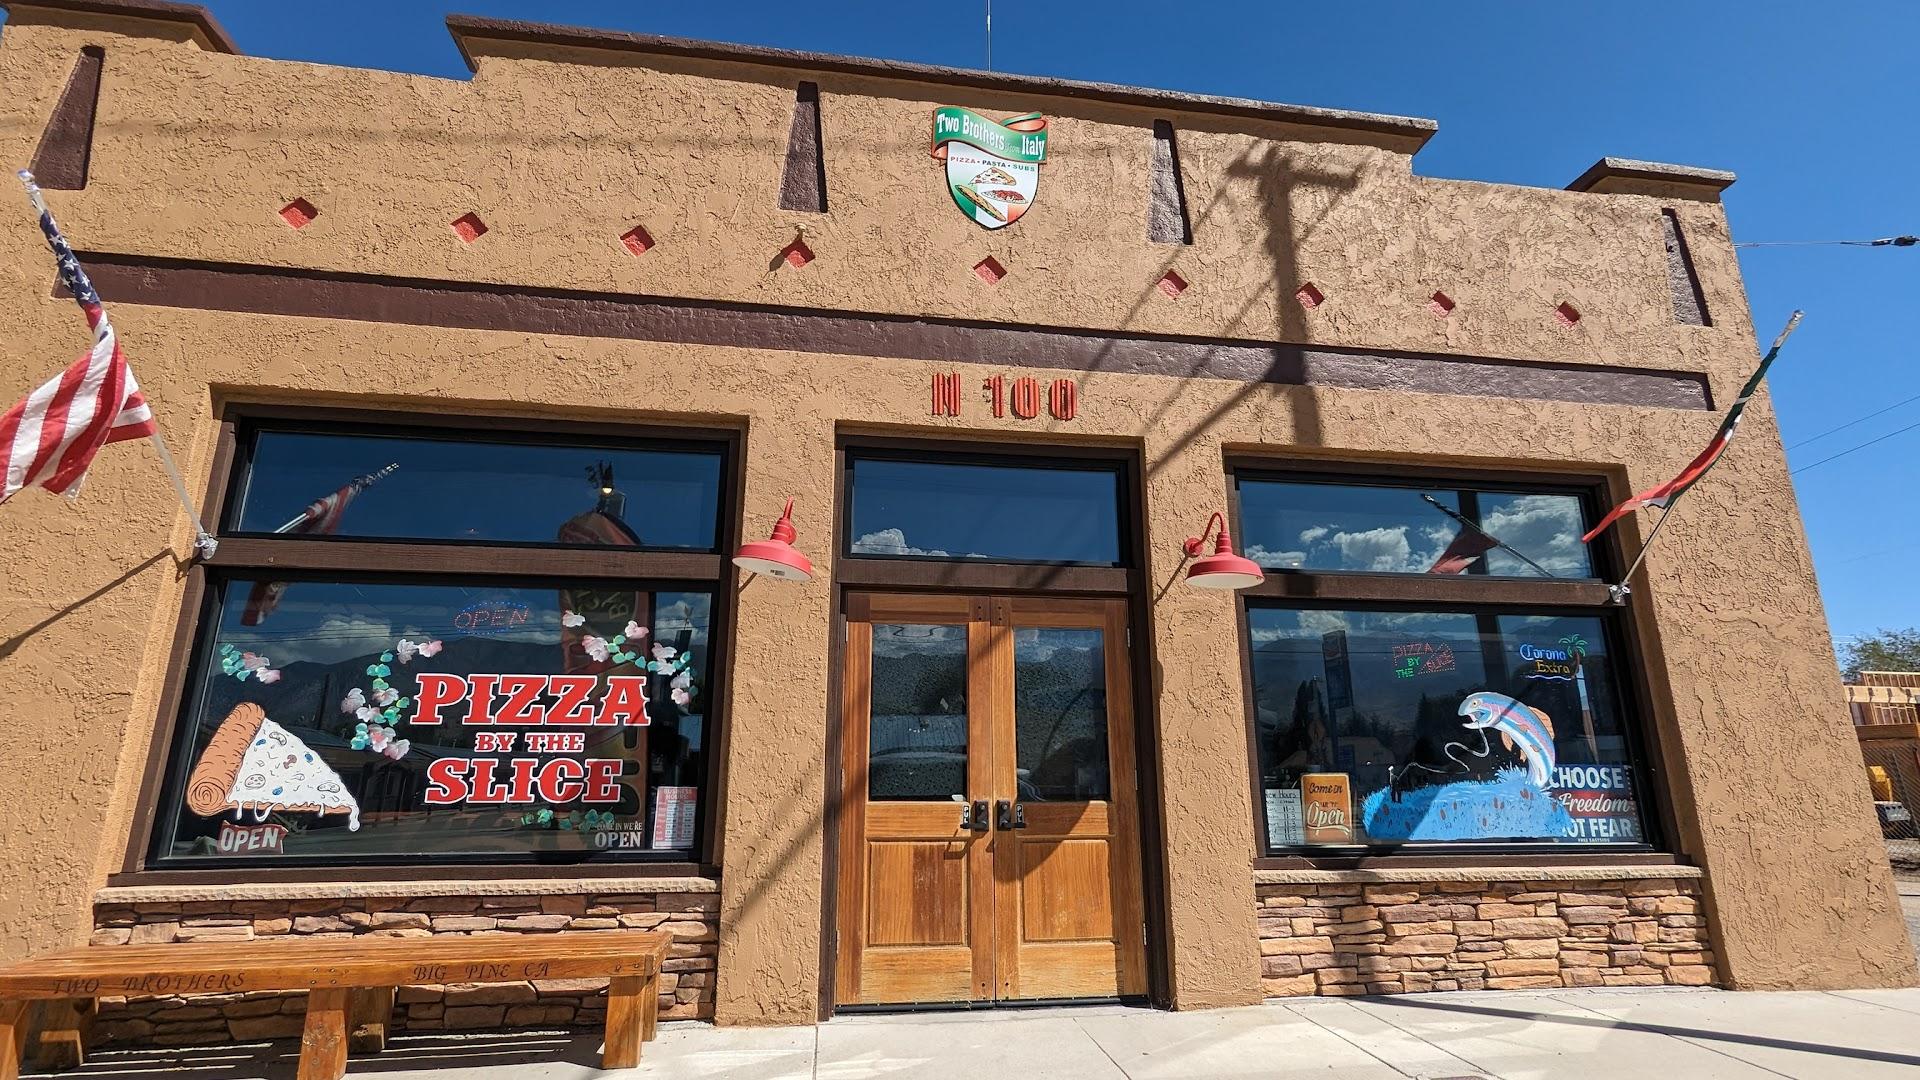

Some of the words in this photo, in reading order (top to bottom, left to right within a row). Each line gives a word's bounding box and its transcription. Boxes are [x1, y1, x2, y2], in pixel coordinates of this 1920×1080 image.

[937, 113, 959, 133] Two
[963, 115, 1005, 151] Brothers
[1022, 135, 1044, 160] Italy
[950, 156, 976, 164] PIZZA
[982, 160, 1006, 168] PASTA
[1012, 164, 1035, 172] SUBS
[932, 372, 961, 416] N
[983, 375, 1077, 421] 100
[454, 607, 529, 629] OPEN
[1392, 642, 1433, 658] PIZZA
[1520, 643, 1566, 660] Corona
[1407, 656, 1420, 667] BY
[1535, 660, 1571, 673] Extra
[1395, 667, 1415, 679] THE
[410, 673, 651, 726] PIZZA
[474, 732, 517, 752] BY
[524, 732, 585, 752] THE
[425, 757, 623, 804] SLICE
[1549, 766, 1624, 788] CHOOSE
[1559, 792, 1631, 813] Freedom
[1307, 800, 1345, 828] Open
[1563, 818, 1585, 837] OT
[1588, 818, 1634, 837] FEAR
[220, 827, 279, 852] OPEN
[594, 831, 642, 848] OPEN
[413, 964, 447, 981] BIG
[465, 963, 511, 979] PINE
[524, 961, 549, 977] CA
[53, 978, 100, 994] TWO
[122, 972, 246, 992] BROTHERS
